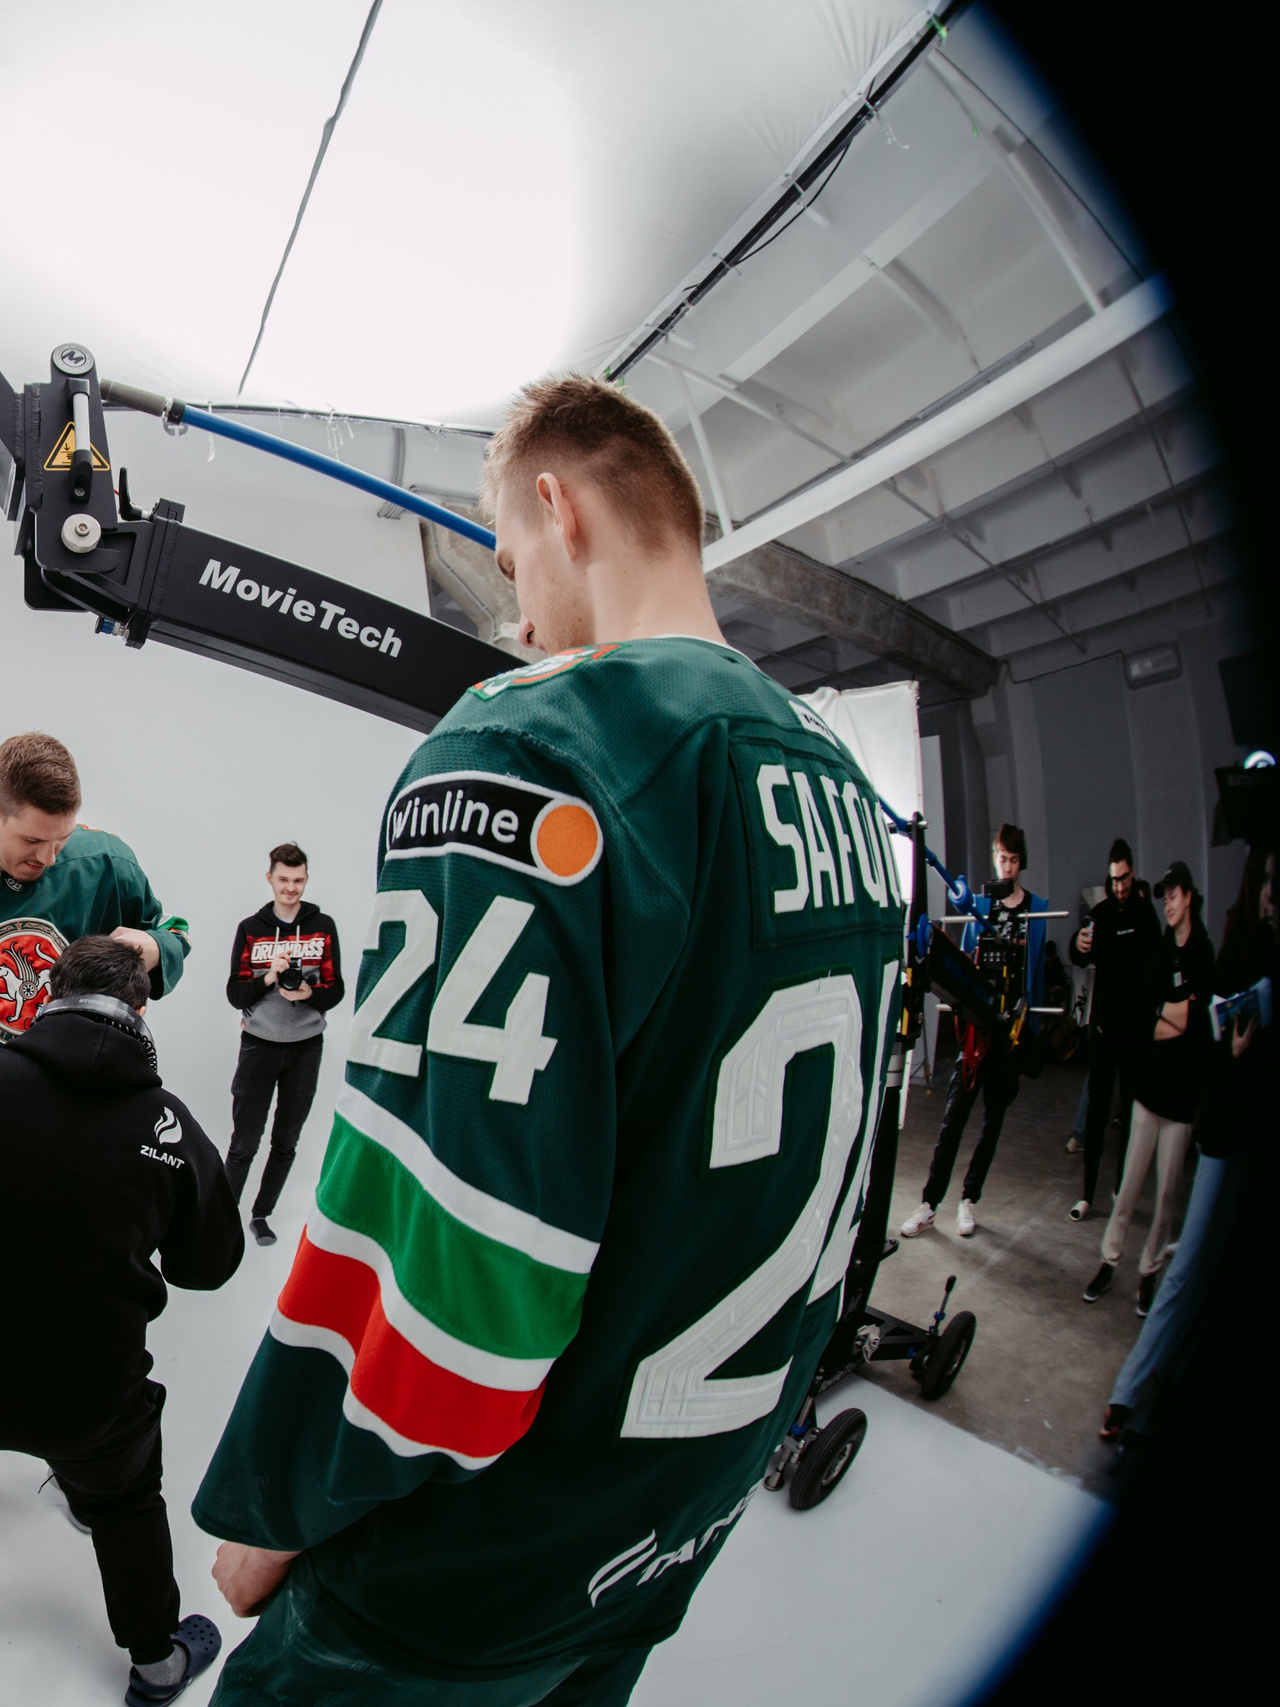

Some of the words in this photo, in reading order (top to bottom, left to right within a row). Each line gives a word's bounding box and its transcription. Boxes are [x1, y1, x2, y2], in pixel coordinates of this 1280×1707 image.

[198, 558, 403, 659] MovieTech
[391, 789, 519, 844] Winline
[344, 889, 558, 1106] 24
[139, 1144, 186, 1170] ZILANT
